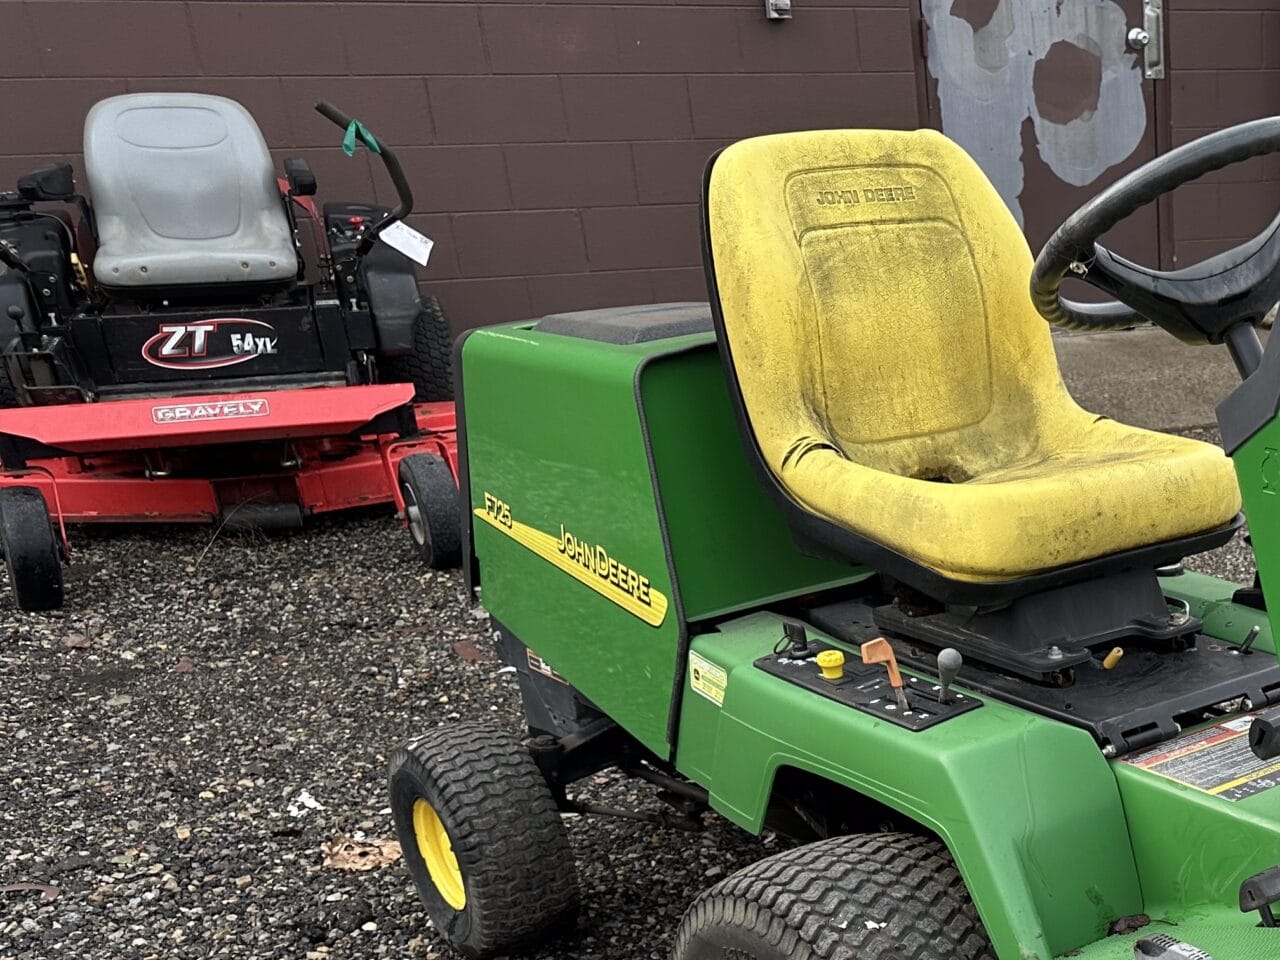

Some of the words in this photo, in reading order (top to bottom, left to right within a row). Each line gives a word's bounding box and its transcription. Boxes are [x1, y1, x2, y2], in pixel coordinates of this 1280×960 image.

[816, 189, 860, 205] JOHN
[862, 186, 916, 203] DEERE
[160, 324, 216, 357] ZT
[156, 400, 265, 422] GRAVELY
[484, 492, 512, 530] F725
[557, 523, 596, 572] JOHN
[595, 543, 652, 608] DEERE
